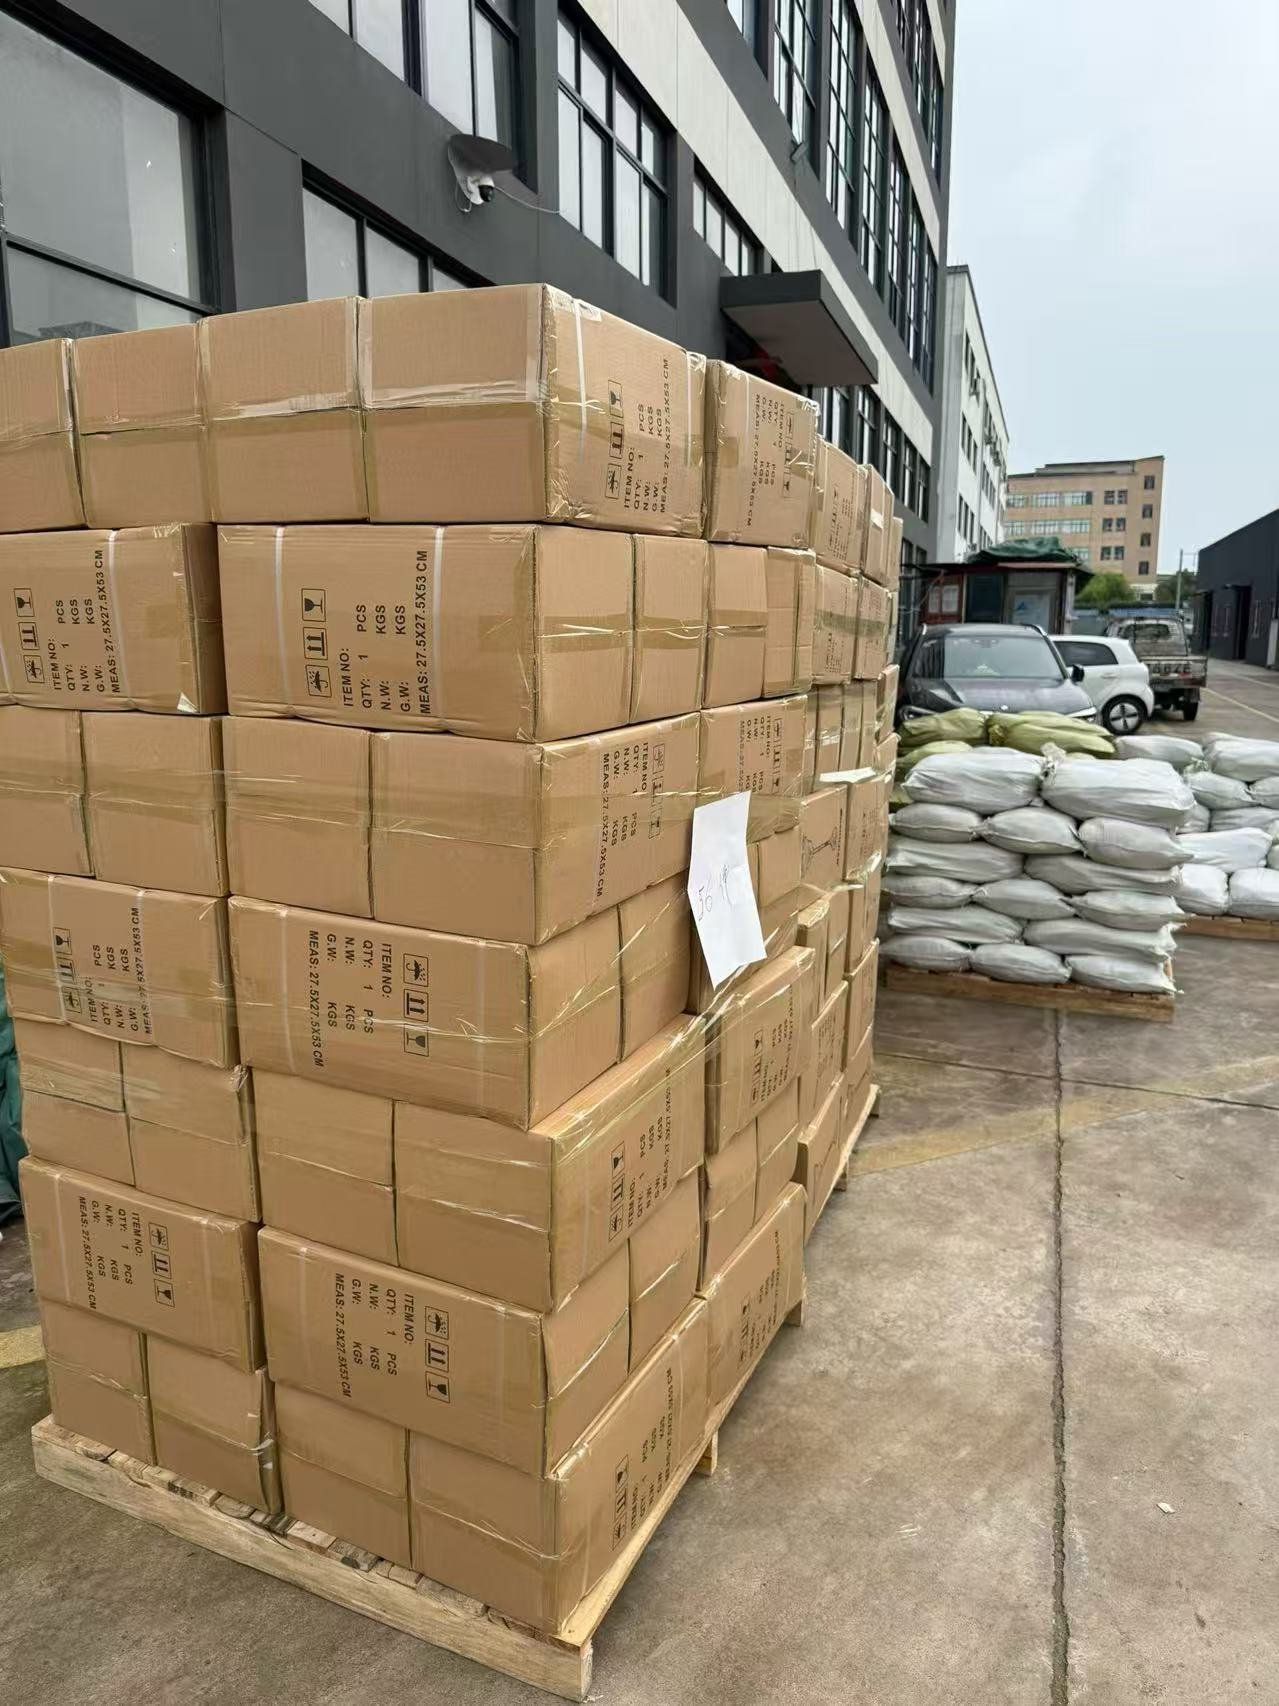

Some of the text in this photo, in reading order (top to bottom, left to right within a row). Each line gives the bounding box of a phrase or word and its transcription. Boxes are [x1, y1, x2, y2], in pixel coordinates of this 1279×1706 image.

[663, 359, 669, 379] CM
[624, 447, 635, 508] ITEM NO:
[633, 479, 641, 510] QTY:
[660, 470, 669, 513] MEAS:
[56, 600, 66, 624] PCS
[94, 550, 120, 693] MEAS: 27.5X27.5X53 CM
[356, 604, 367, 632] PCS
[415, 550, 431, 714] MEAS: 27.5X27.5X53 CM
[47, 638, 62, 691] ITEM NO:
[70, 599, 90, 692] N.W: KGS
[84, 598, 105, 692] G.W: KGS
[375, 605, 392, 710] N.W: KGS
[395, 605, 410, 712] G.W: KGS
[65, 664, 76, 691] QTY:
[339, 648, 353, 707] ITEM NO:
[361, 677, 372, 708] QTY:
[602, 753, 610, 794] MEAS:
[630, 812, 638, 837] PCS
[596, 878, 605, 897] CM
[131, 908, 139, 924] CM
[93, 944, 102, 966] PCS
[327, 933, 337, 1027] G.W: KGS
[363, 940, 373, 969] QTY:
[382, 943, 392, 999] ITEM NO:
[88, 998, 98, 1022] ITEM
[106, 947, 125, 1029] N.W: KGS
[120, 949, 139, 1031] G.W: KGS
[309, 930, 323, 1067] MEAS: 27.5X27.5X53 CM
[345, 936, 355, 1031] N.W: KGS
[101, 1002, 111, 1025] QTY:
[364, 1009, 374, 1034] PCS
[79, 1196, 88, 1228] MEAS:
[88, 1294, 96, 1309] CM
[92, 1200, 106, 1277] G.W: KGS
[105, 1204, 119, 1280] N.W: KGS
[118, 1208, 127, 1232] QTY:
[124, 1264, 133, 1285] PCS
[131, 1212, 143, 1257] ITEM NO:
[352, 1278, 362, 1365] G.W: KGS
[369, 1283, 380, 1370] N.W: KGS
[386, 1288, 396, 1315] QTY:
[404, 1294, 414, 1345] ITEM NO:
[335, 1273, 351, 1398] MEAS: 27.5X27.5X53 CM
[387, 1352, 397, 1376] PCS
